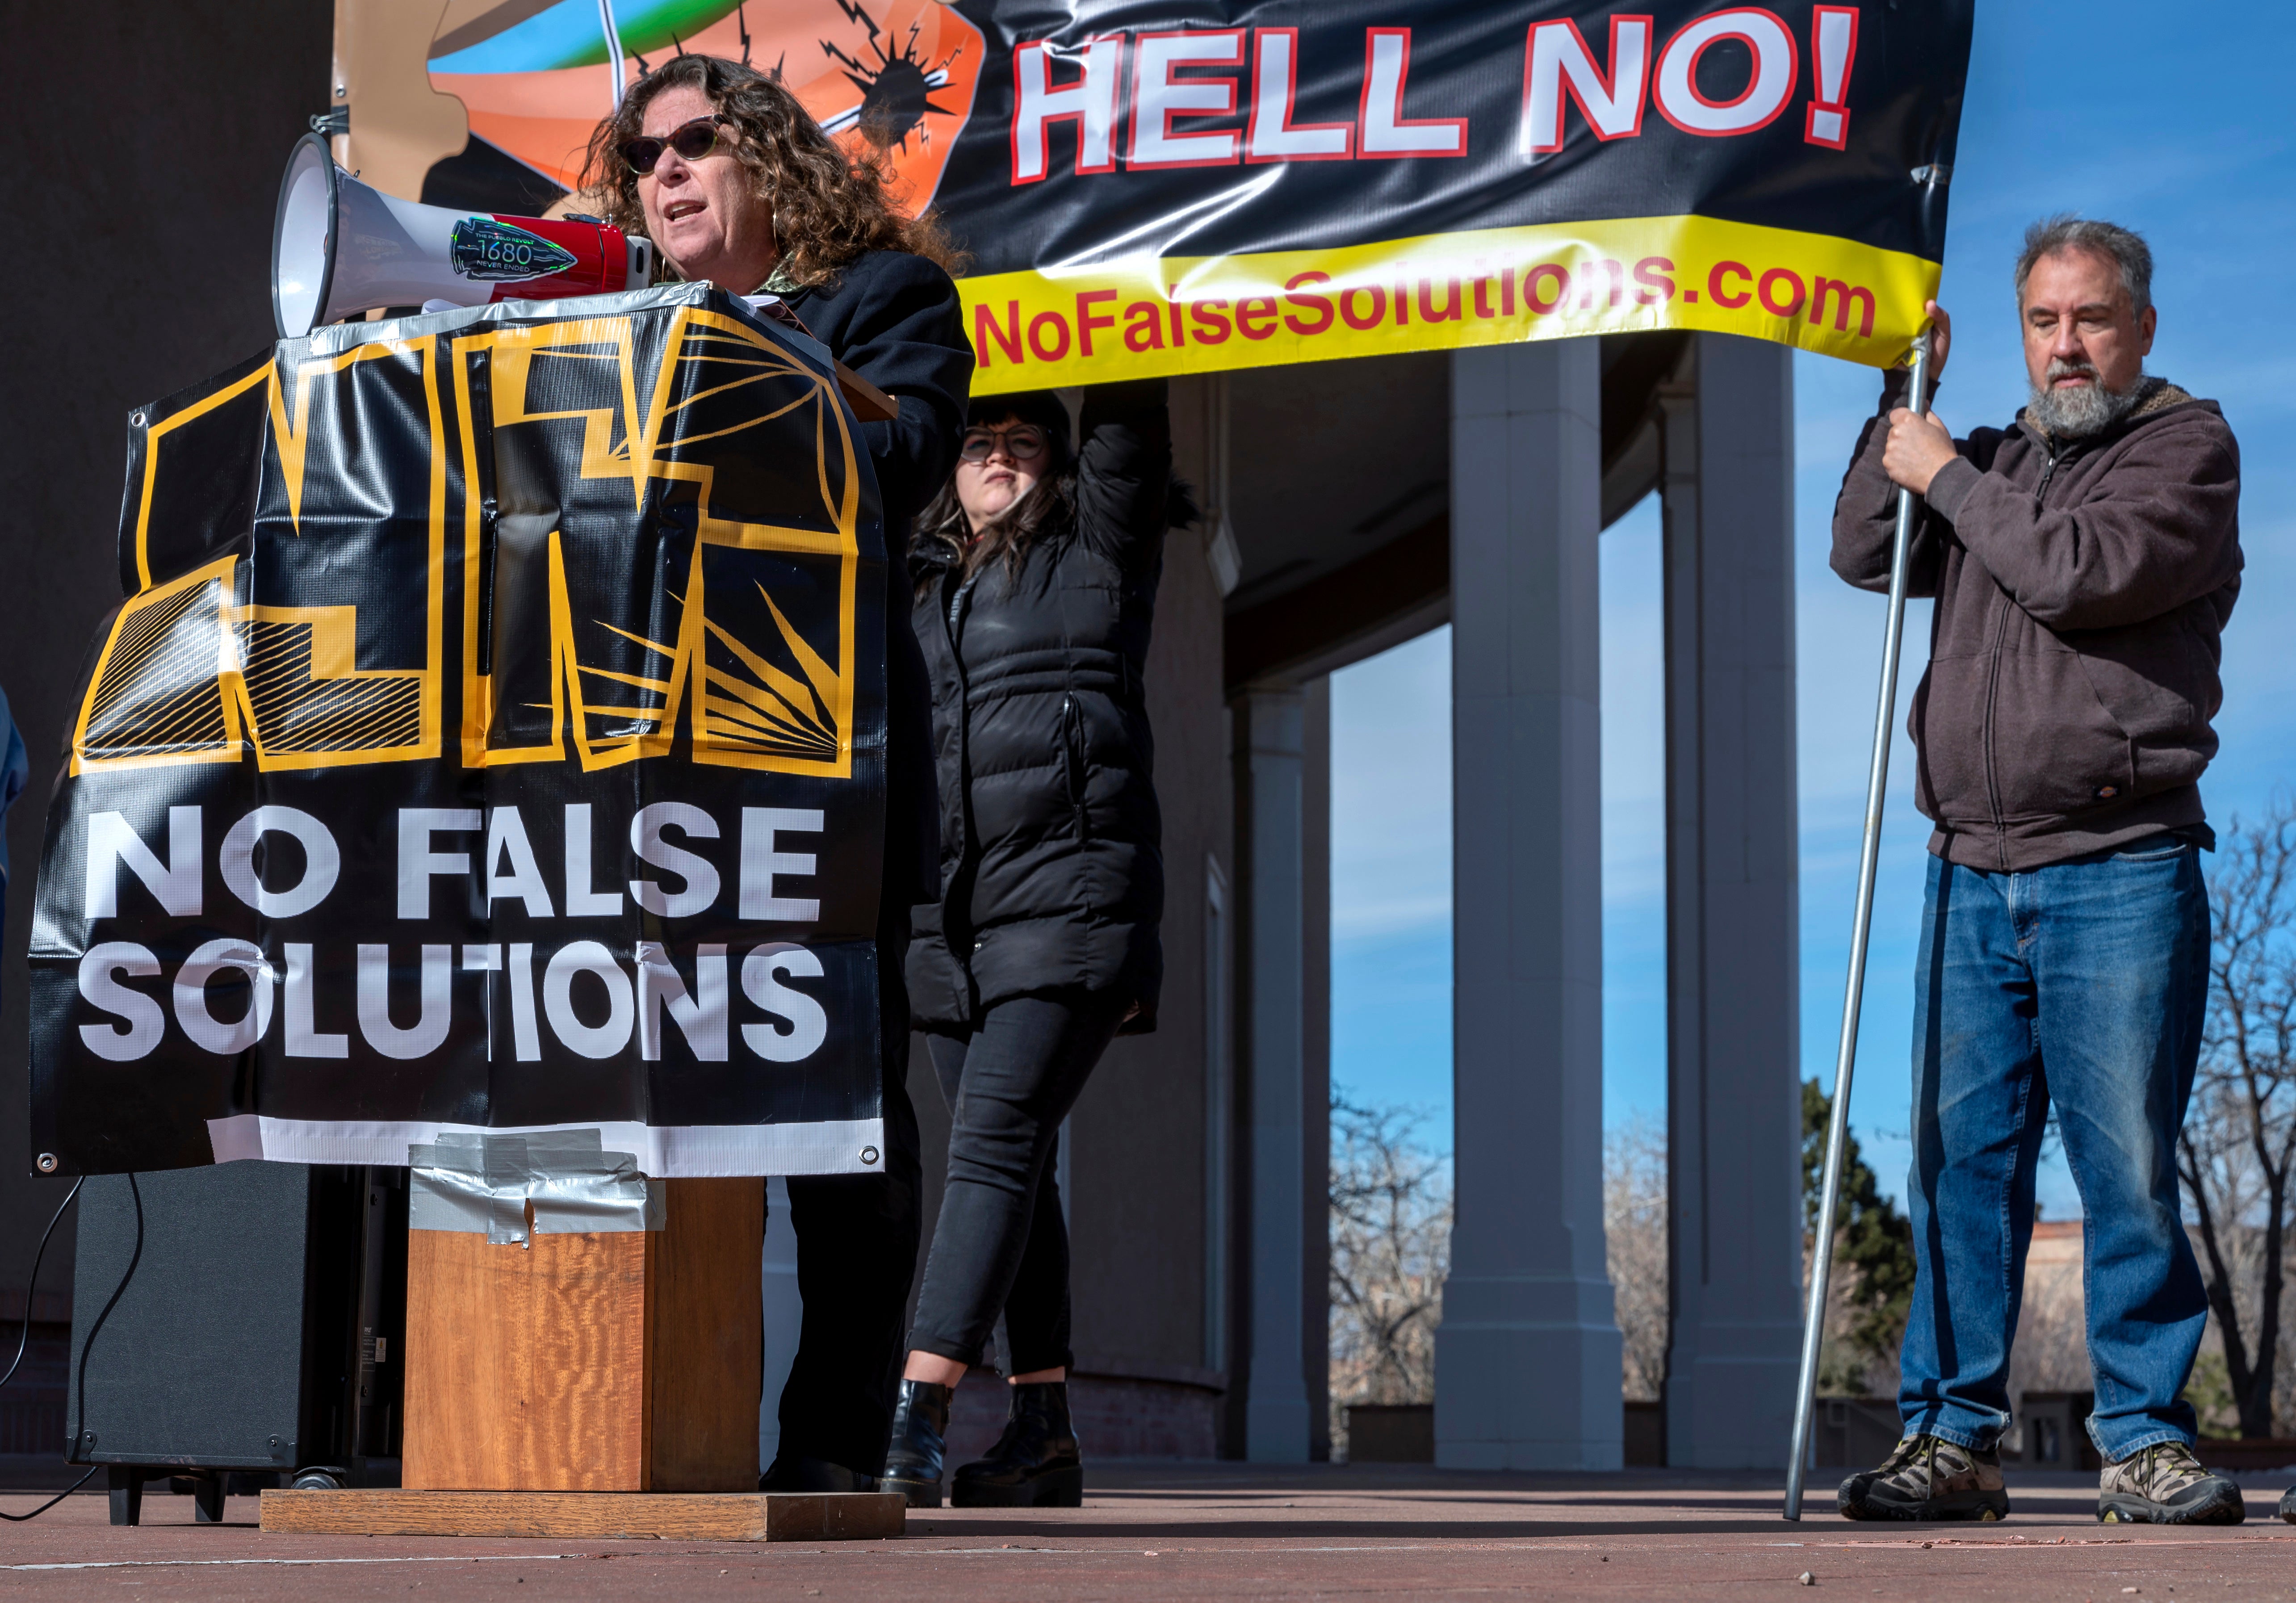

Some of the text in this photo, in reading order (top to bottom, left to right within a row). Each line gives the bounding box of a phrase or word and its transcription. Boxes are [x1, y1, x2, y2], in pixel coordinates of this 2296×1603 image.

[1010, 5, 1859, 186] HELL NO!
[477, 260, 530, 272] NEVER ENDED
[478, 240, 532, 264] 1680
[974, 252, 1876, 369] NoFalseSolutions.com
[84, 802, 825, 921] NO FALSE
